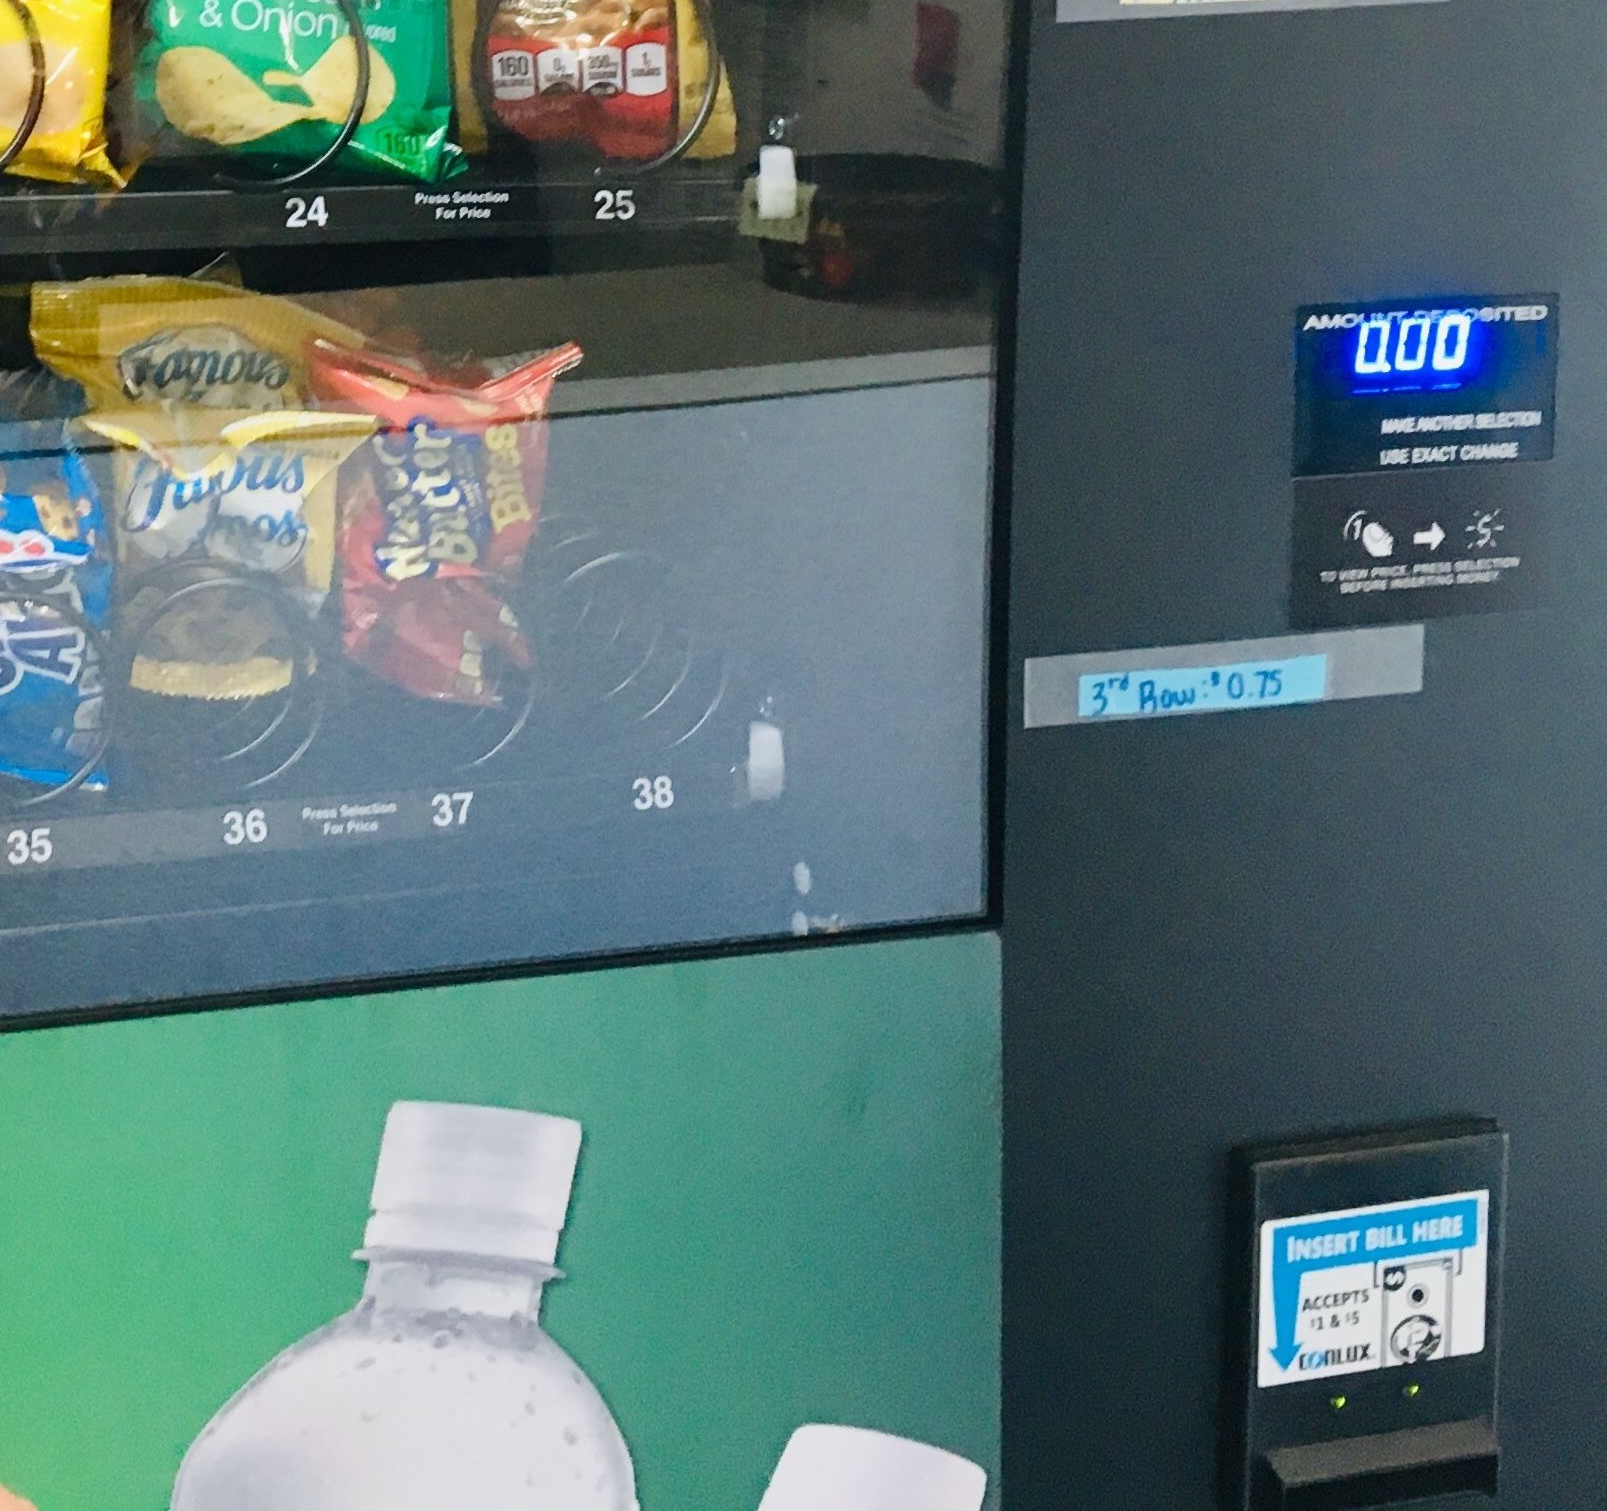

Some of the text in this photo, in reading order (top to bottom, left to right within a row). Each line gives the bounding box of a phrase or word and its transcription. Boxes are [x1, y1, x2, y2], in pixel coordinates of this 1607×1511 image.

[285, 196, 329, 228] 24
[414, 191, 510, 205] Press Selection
[435, 207, 492, 220] For Price
[593, 189, 636, 221] 25
[1353, 314, 1472, 374] 0.00
[1379, 441, 1520, 466] USE EXACT CHANGE
[431, 791, 475, 827] 37
[632, 775, 675, 811] 38
[222, 808, 268, 845] 36
[6, 827, 54, 865] 35
[1286, 1214, 1464, 1264] INSERT BILL HERE
[1301, 1288, 1371, 1312] ACCEPTS
[1329, 1314, 1341, 1329] &
[1298, 1342, 1373, 1372] CONLUX
